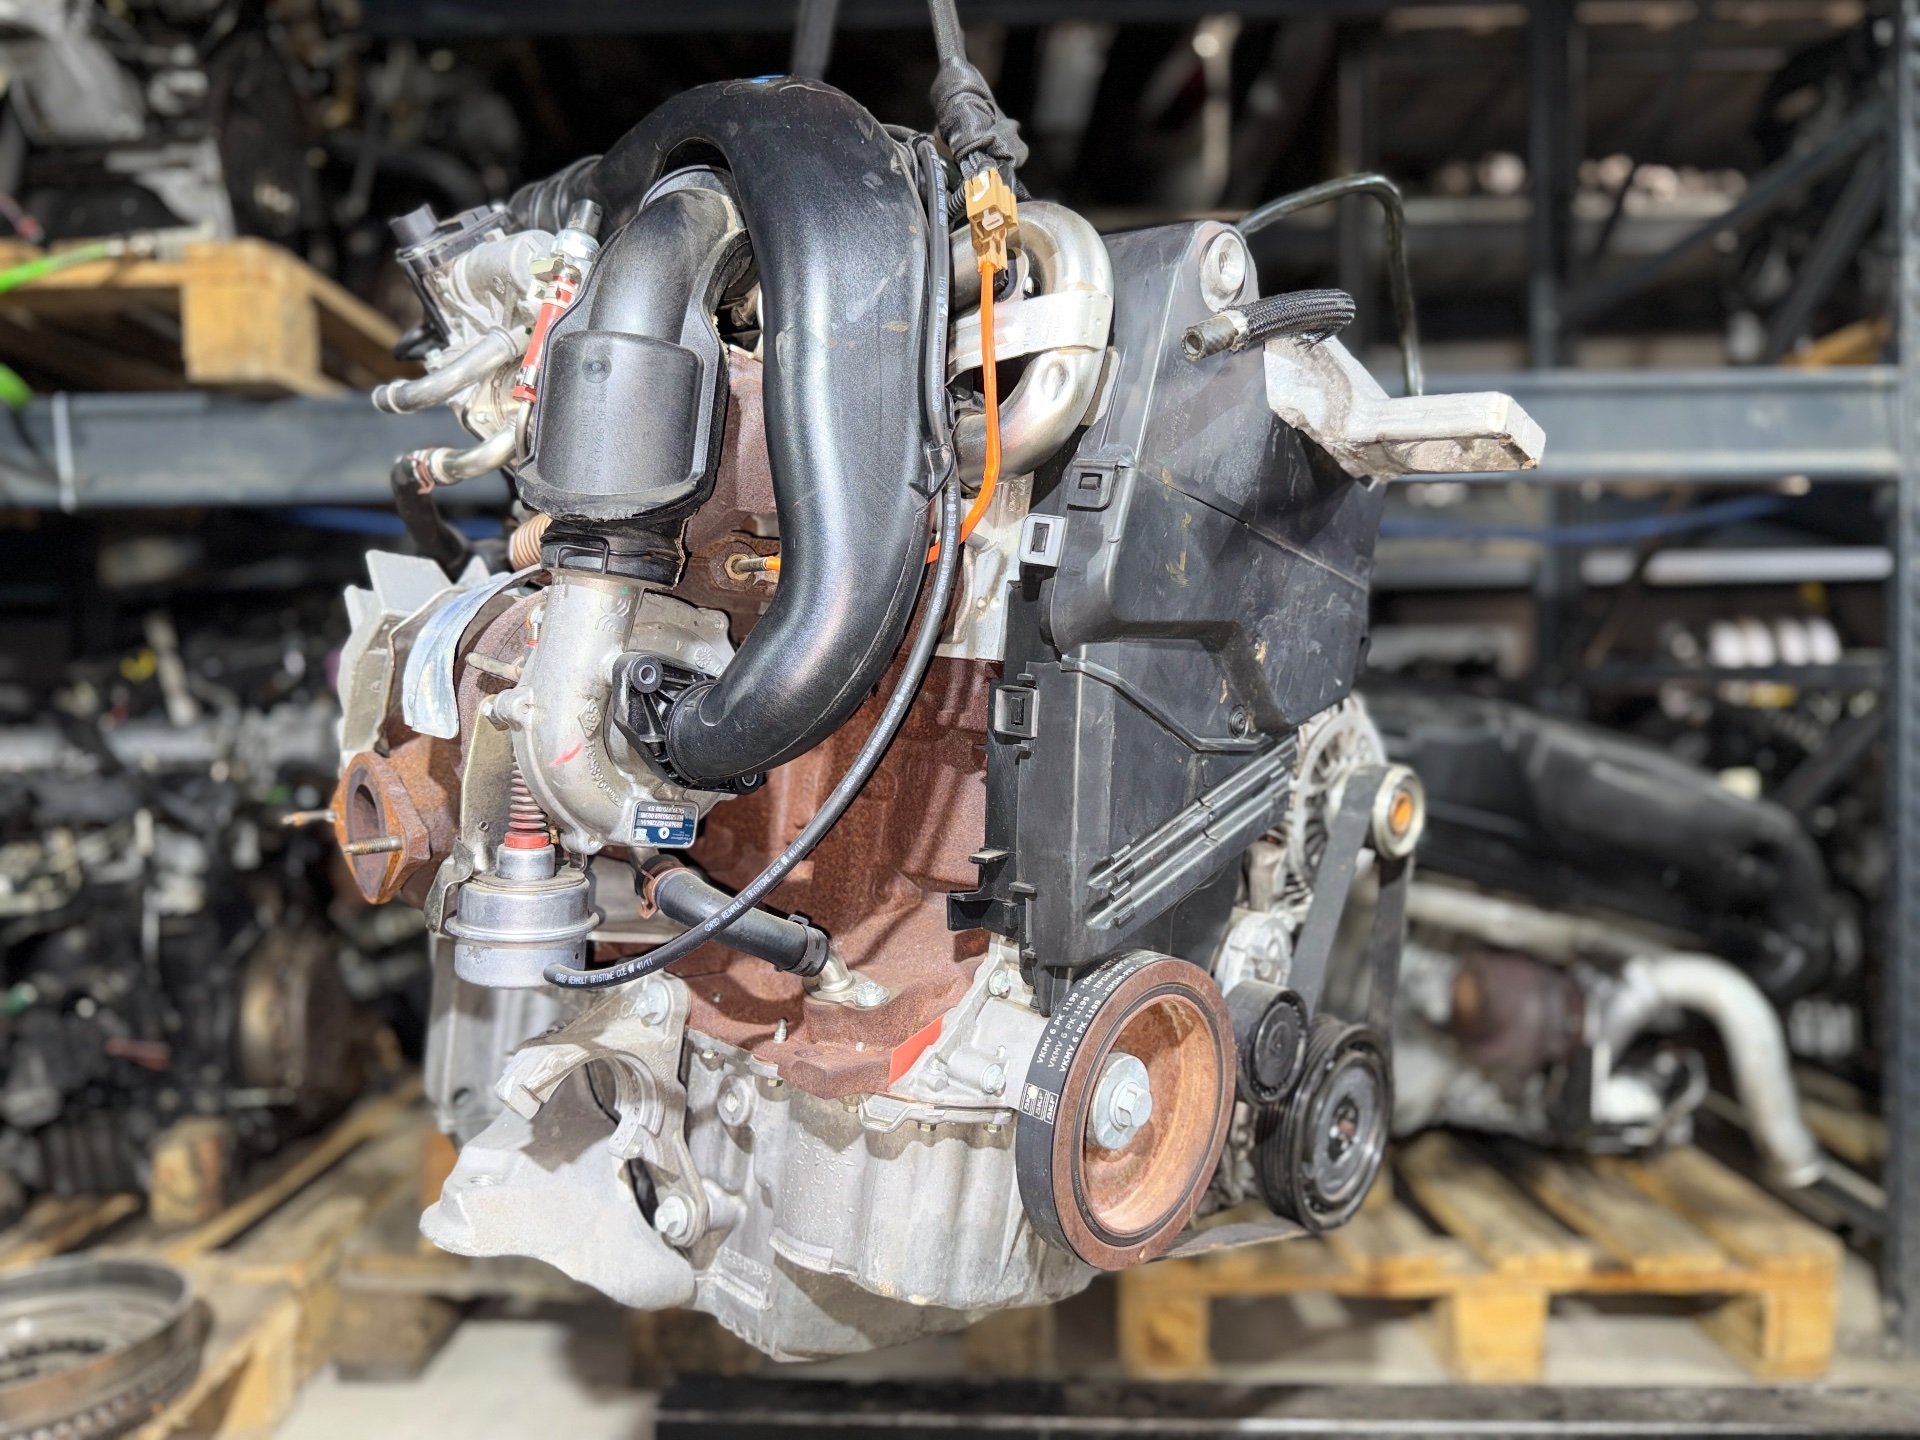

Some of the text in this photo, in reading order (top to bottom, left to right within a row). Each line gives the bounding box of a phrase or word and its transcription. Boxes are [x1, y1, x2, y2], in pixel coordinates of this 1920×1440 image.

[721, 897, 746, 921] RENAULT
[745, 873, 772, 899] TRISTONE
[788, 840, 805, 859] 41/11
[1036, 1036, 1051, 1064] VKMV
[1050, 1027, 1056, 1035] 6
[1054, 1012, 1065, 1027] PK
[1063, 991, 1080, 1012] 1199
[1047, 1040, 1064, 1069] VKMV
[1060, 1031, 1068, 1039] 6
[1065, 1016, 1077, 1031] PK
[1073, 995, 1090, 1016] 1199
[1058, 1044, 1073, 1073] VKMV
[1072, 1035, 1079, 1043] 6
[1077, 1020, 1088, 1034] PK
[1084, 999, 1102, 1020] 1199
[1034, 1090, 1045, 1116] SKF
[1046, 1095, 1057, 1122] SKF
